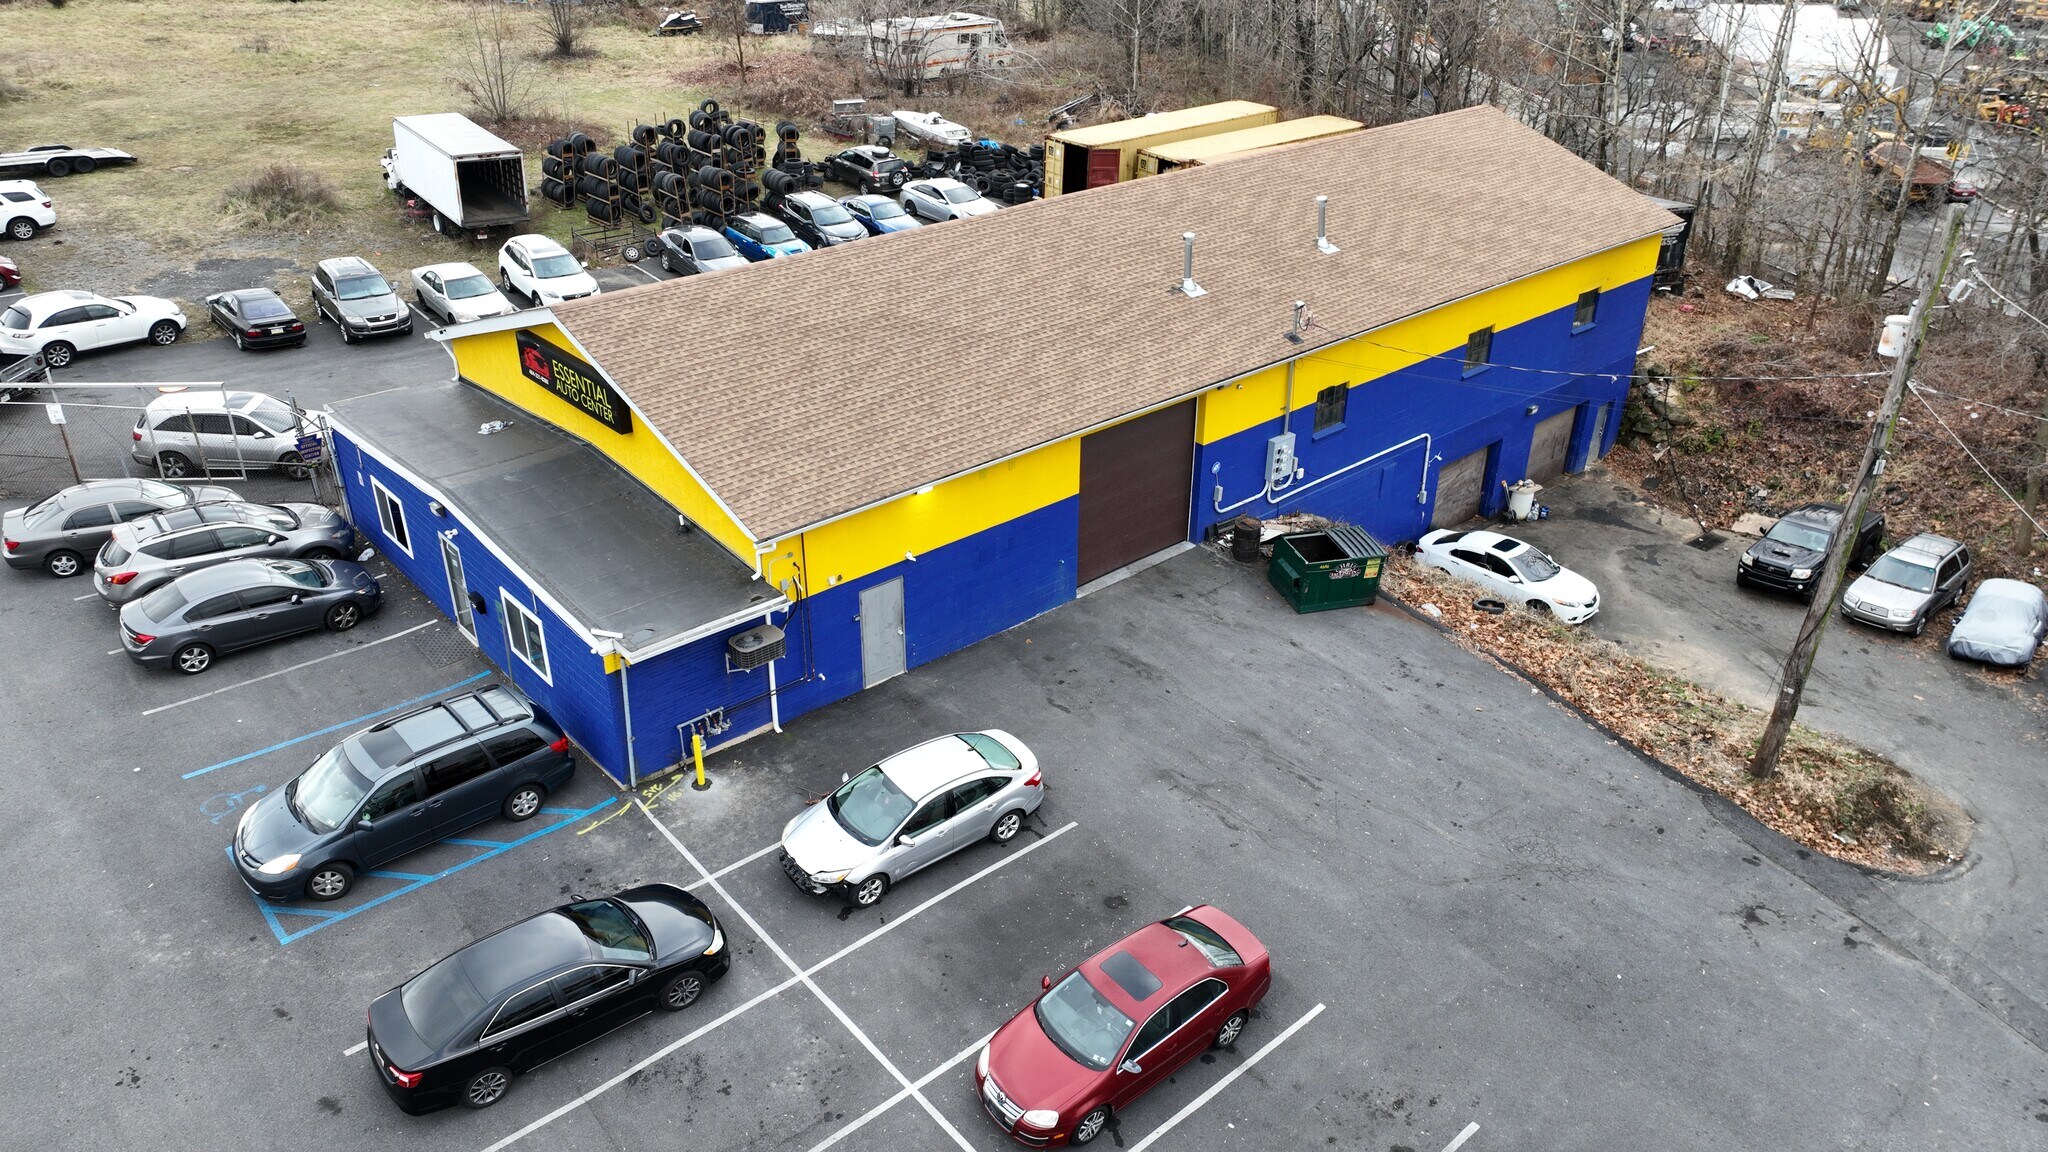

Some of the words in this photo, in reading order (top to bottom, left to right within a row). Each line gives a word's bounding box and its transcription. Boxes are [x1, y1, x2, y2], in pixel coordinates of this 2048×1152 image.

[551, 359, 612, 409] ESSENTIAL
[556, 380, 580, 402] AUTO
[580, 394, 615, 424] CENTER
